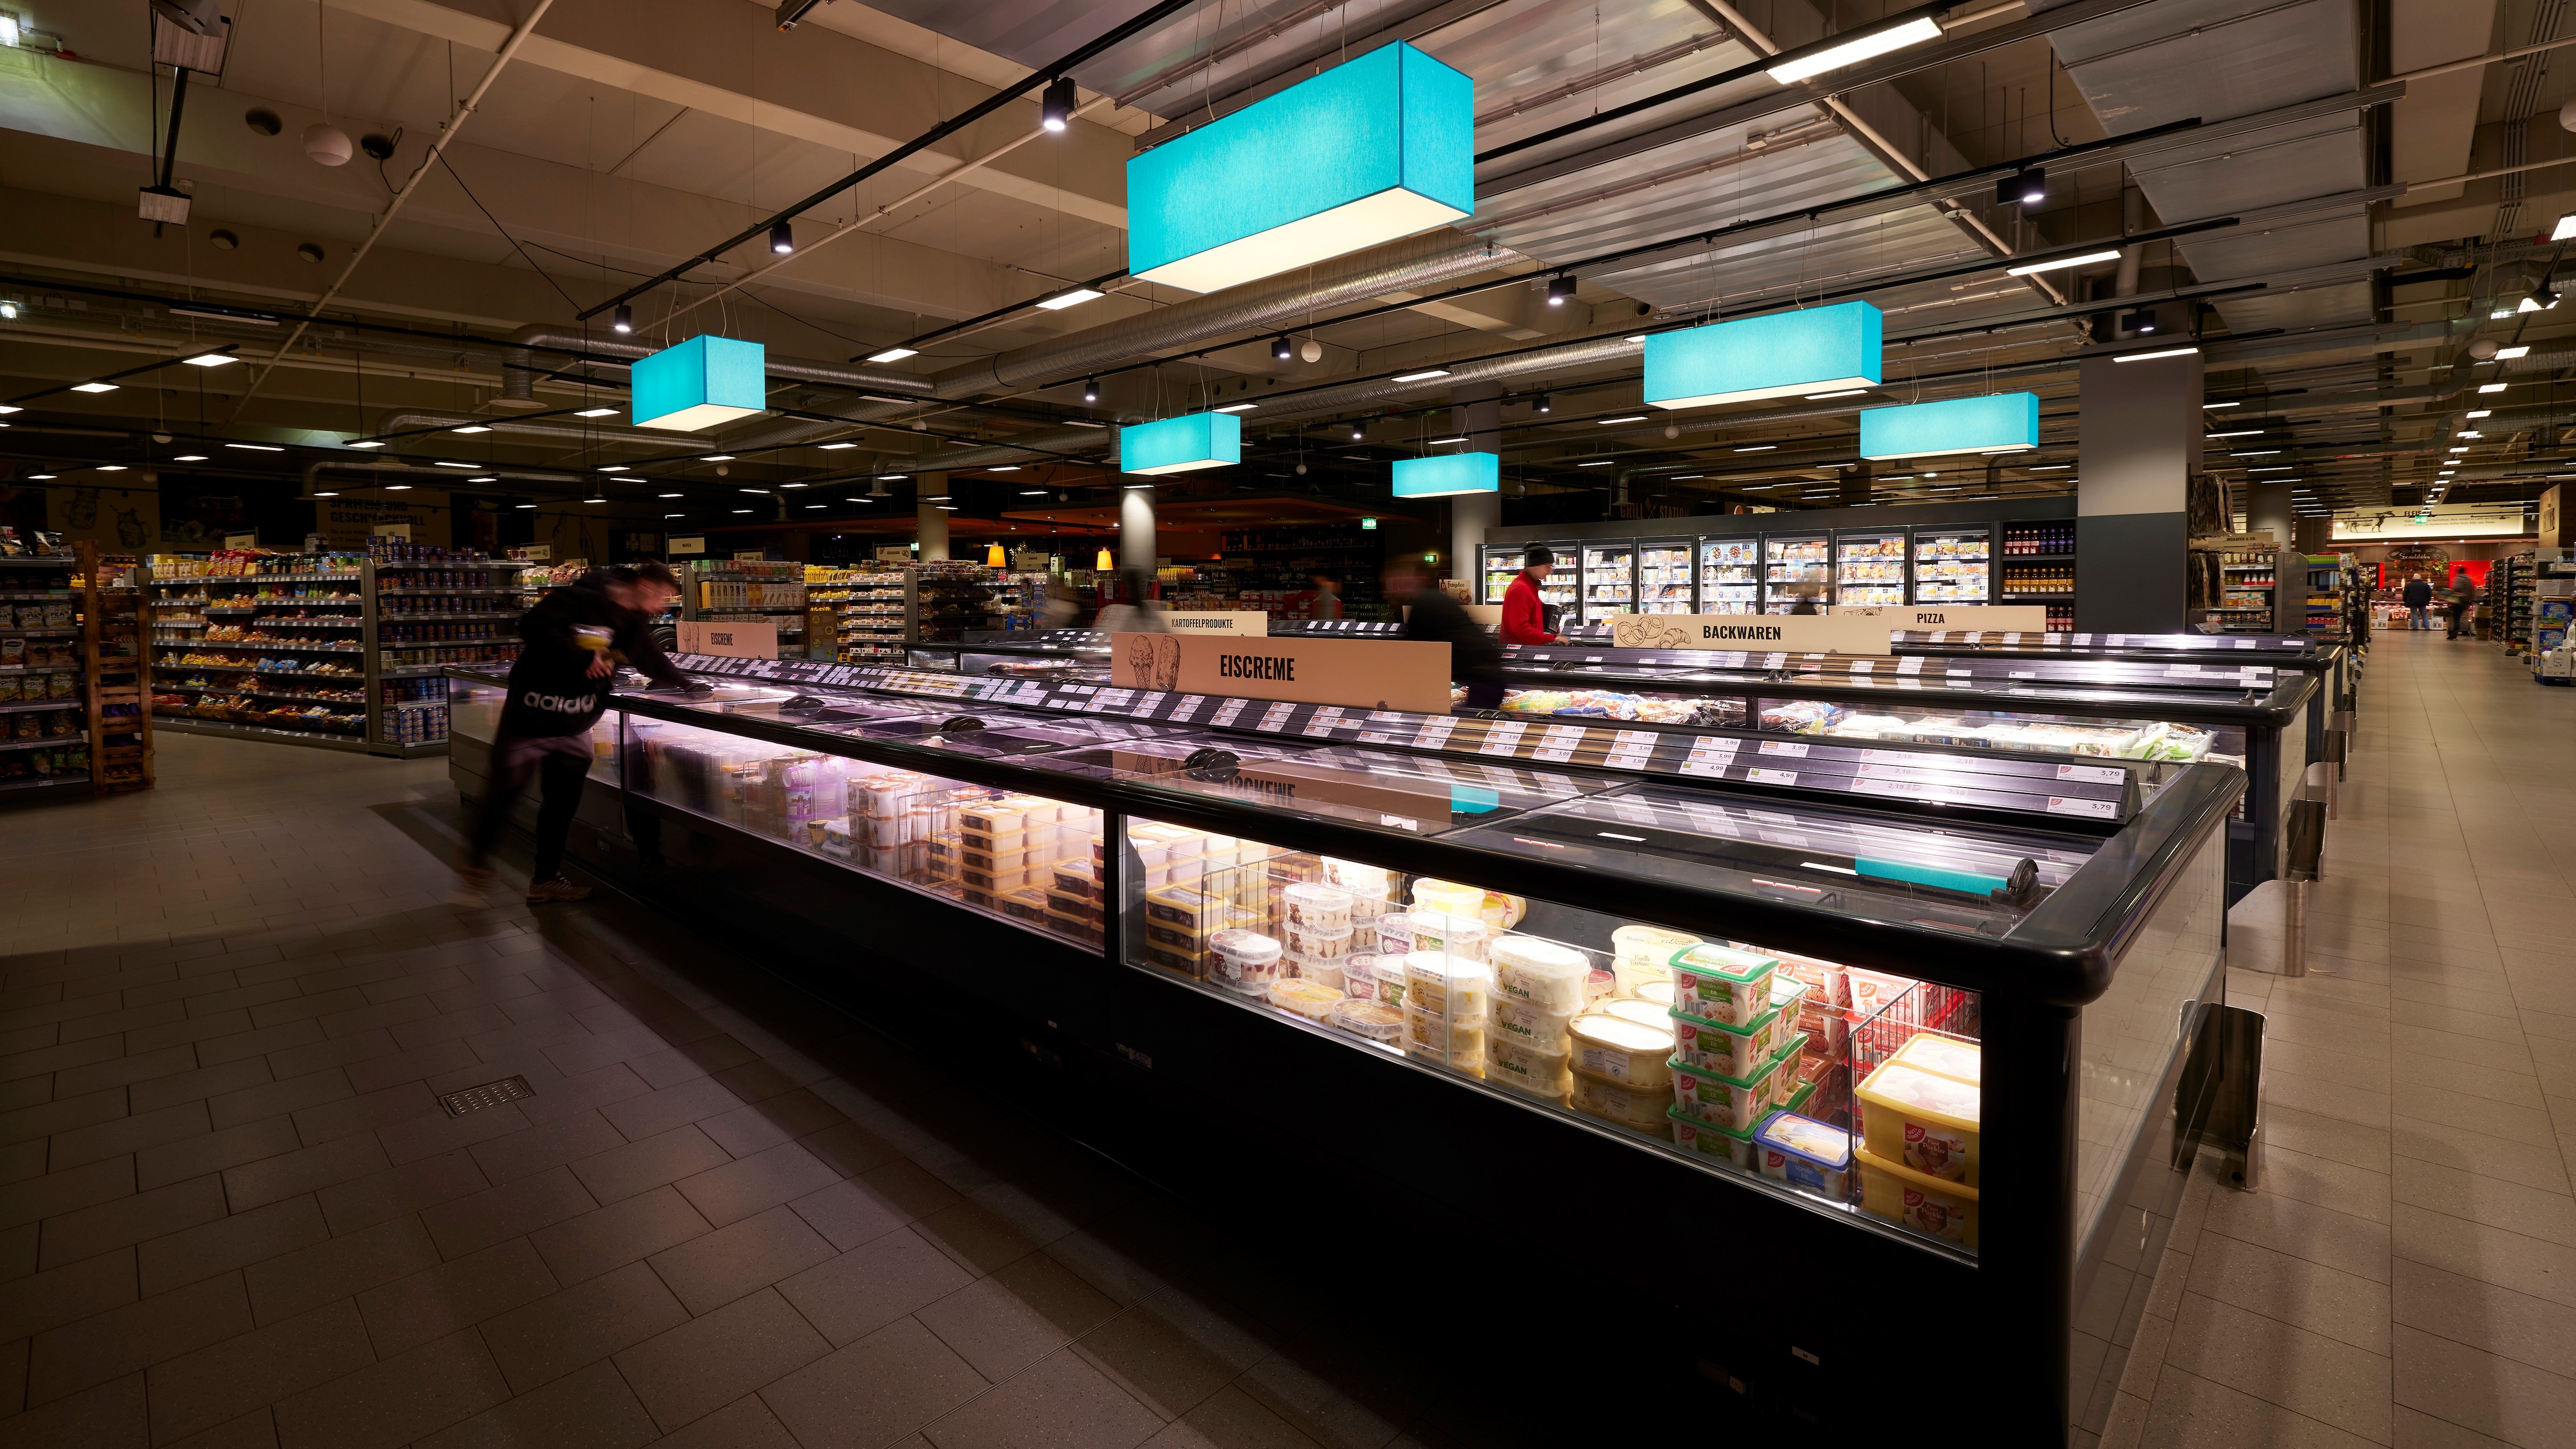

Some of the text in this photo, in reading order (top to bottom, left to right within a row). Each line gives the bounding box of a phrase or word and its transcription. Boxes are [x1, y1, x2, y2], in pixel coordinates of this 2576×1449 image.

[1620, 503, 1643, 518] GRILL
[1172, 618, 1233, 628] KARTOFFELPRODUKTE
[1917, 613, 1945, 624] PIZZA
[1703, 626, 1781, 640] BACKWAREN
[711, 633, 733, 646] EISCREME
[1221, 654, 1295, 681] EISCREME
[1796, 970, 1822, 979] Schokoladen-
[1504, 983, 1529, 998] VEGAN
[1502, 1021, 1531, 1036] VEGAN
[1703, 1034, 1724, 1042] Walnuss-
[1499, 1060, 1527, 1075] VEGAN
[1702, 1085, 1723, 1093] Walnuss-
[1907, 1129, 1922, 1139] GÜNSTIG
[1702, 1136, 1723, 1144] Walnuss-
[1922, 1142, 1945, 1154] Pückler
[1814, 1151, 1833, 1159] EDEKA
[1795, 1165, 1814, 1174] Vanille-
